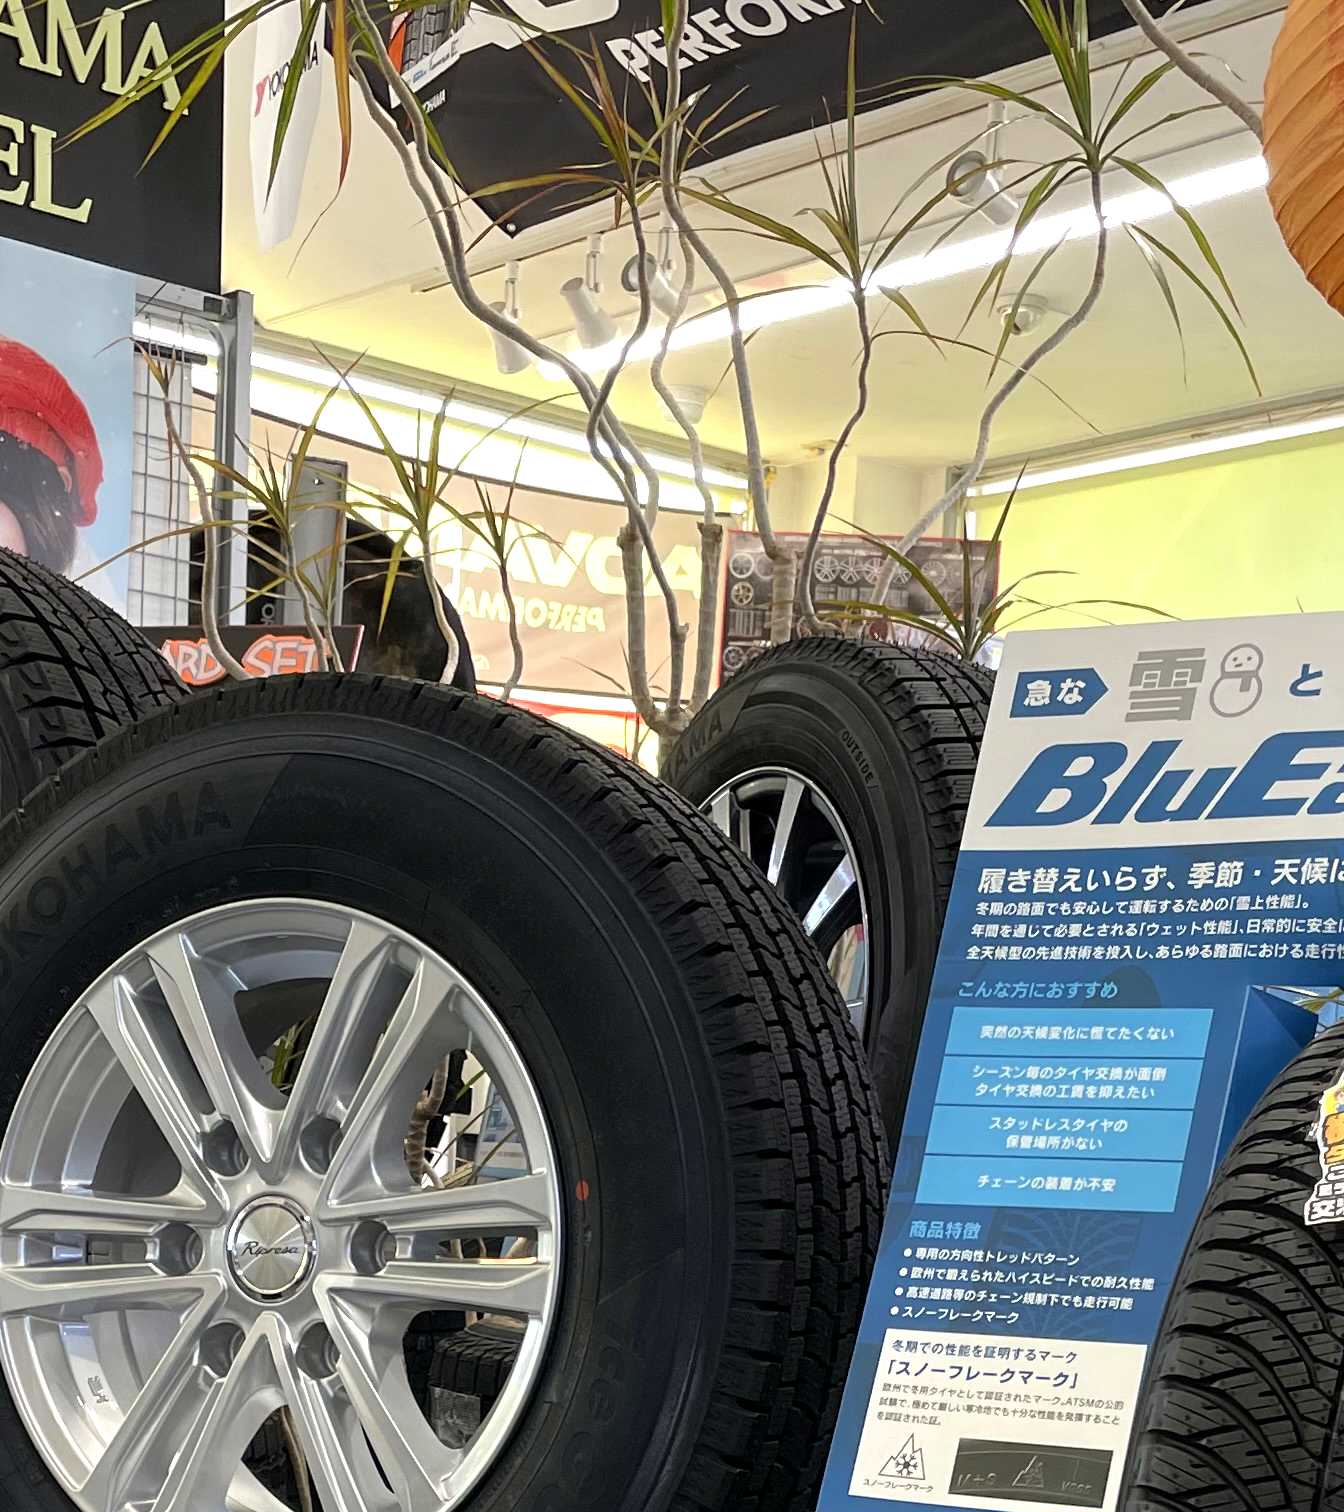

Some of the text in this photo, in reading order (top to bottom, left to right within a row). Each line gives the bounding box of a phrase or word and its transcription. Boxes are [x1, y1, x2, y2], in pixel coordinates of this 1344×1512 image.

[1022, 677, 1084, 706] 急な
[1124, 648, 1207, 722] 雪
[1288, 663, 1324, 698] と
[841, 731, 874, 783] OUTSIDE
[958, 981, 1118, 999] こんな方におすすめ
[989, 1117, 1128, 1132] スタッドレスタイヤの
[1006, 1136, 1102, 1150] 保管場所がない
[977, 1175, 1116, 1192] チェーンの装着が不安
[909, 1221, 981, 1240] 商品特徴
[902, 1307, 1019, 1324] スノーフレークマーク
[887, 1359, 1078, 1389] 「スノーフレークマーク」
